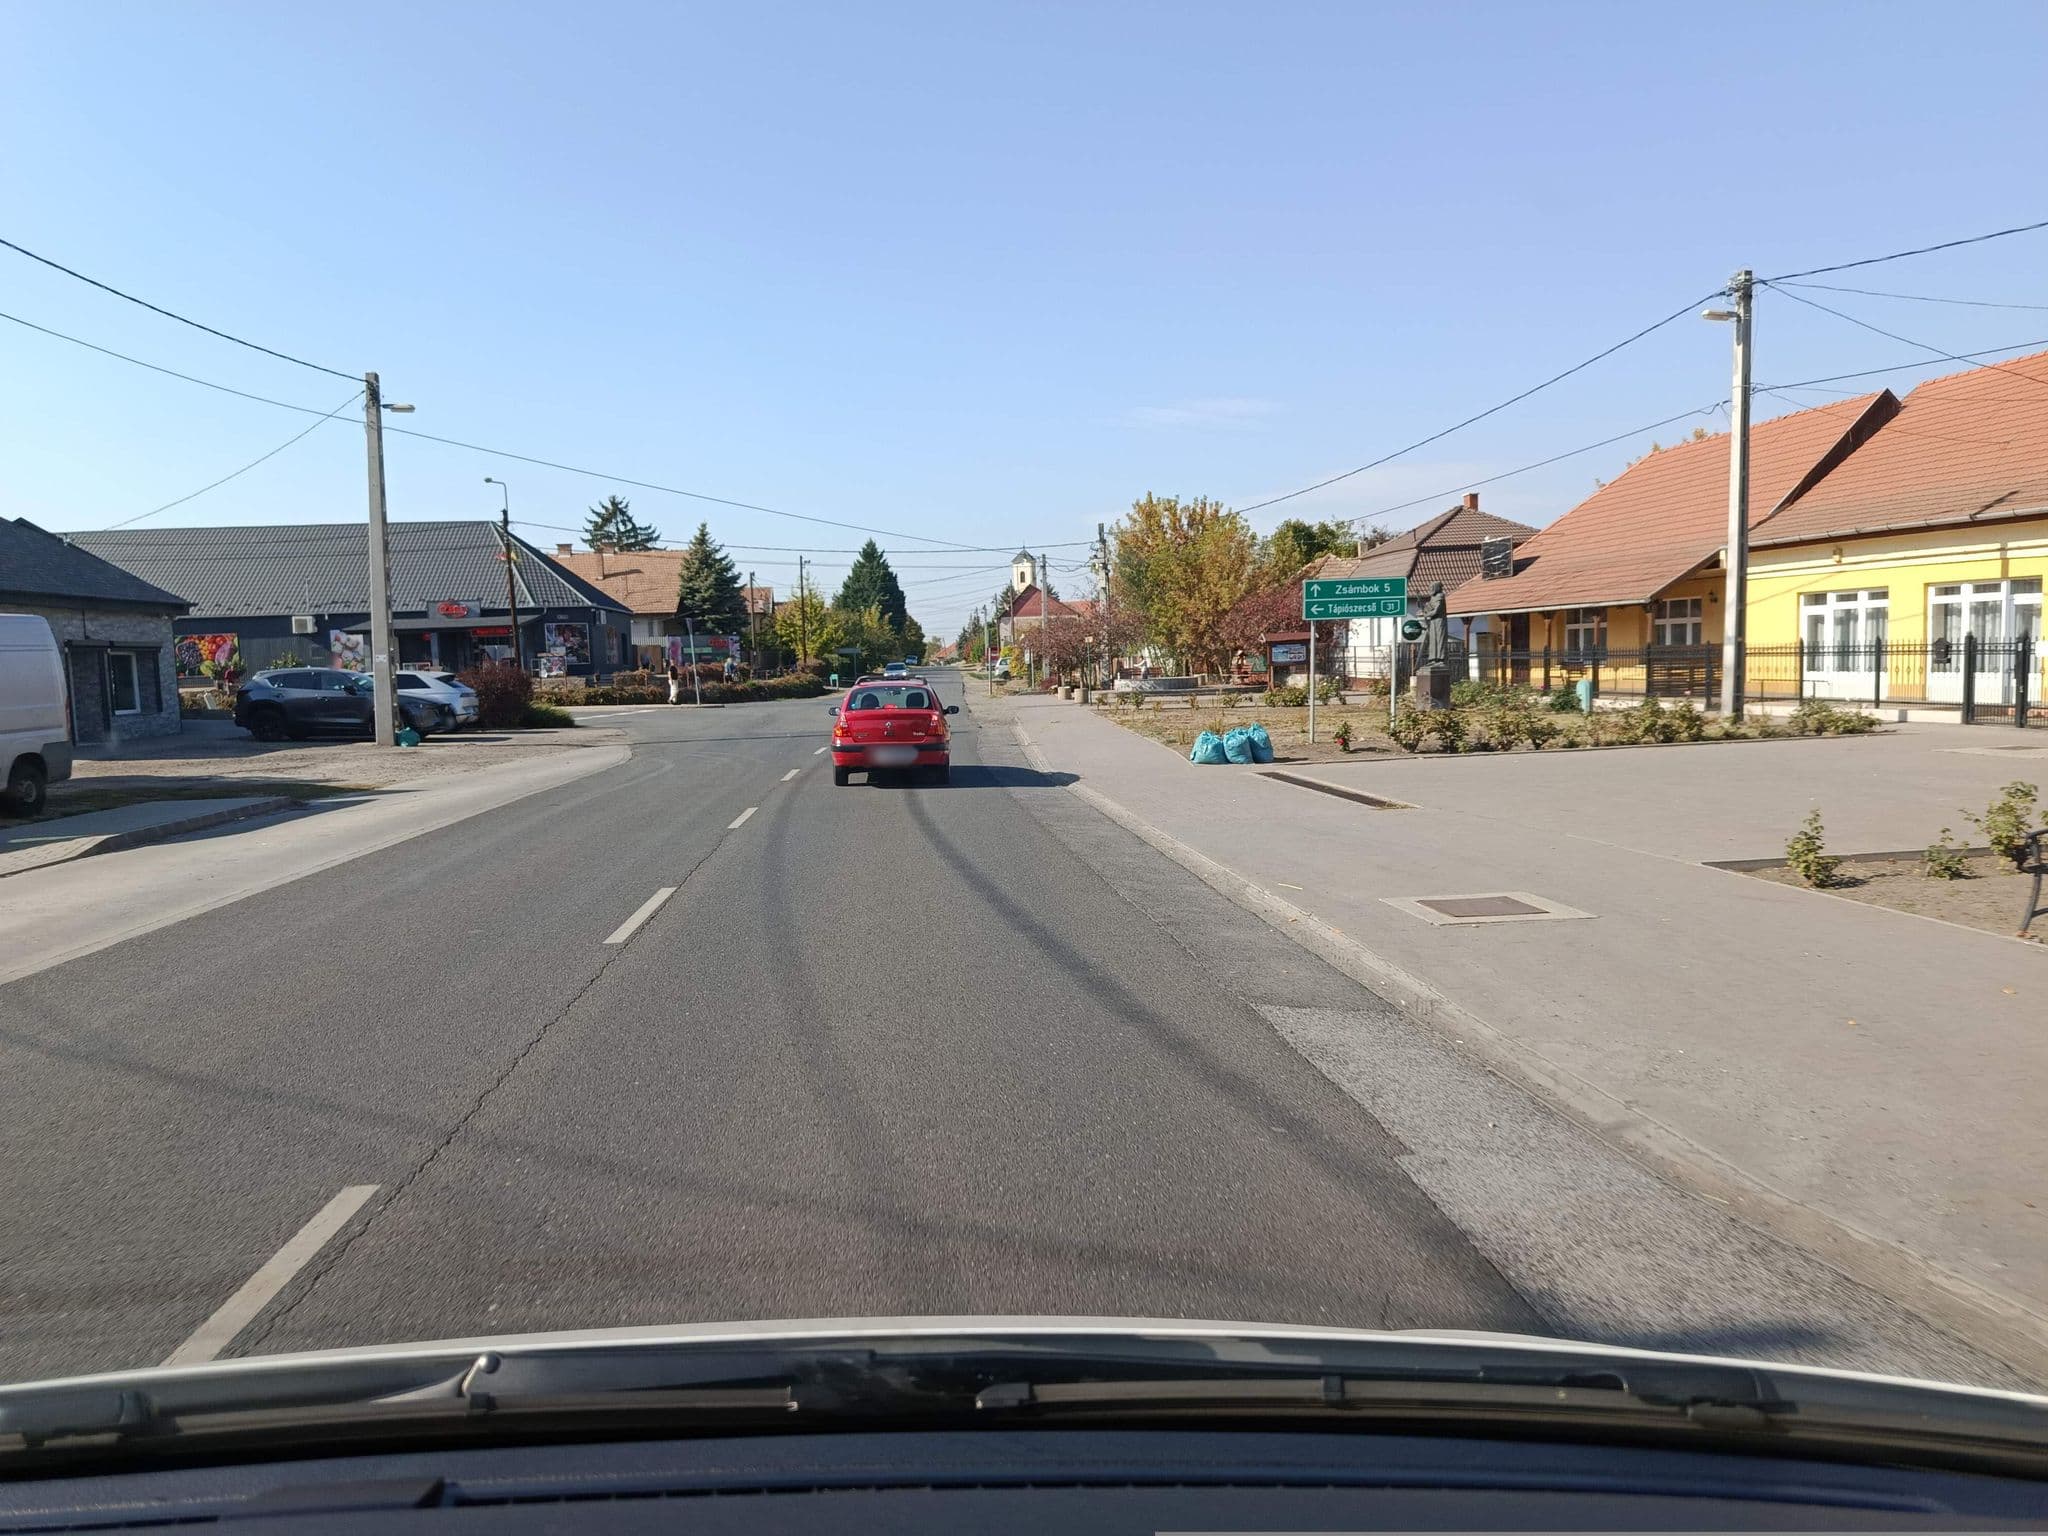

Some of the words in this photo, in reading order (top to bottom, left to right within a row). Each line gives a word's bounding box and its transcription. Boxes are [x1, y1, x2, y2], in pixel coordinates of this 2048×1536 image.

[1335, 583, 1379, 595] Zsámbok
[1384, 583, 1391, 592] 5
[1328, 602, 1377, 615] Tápiószecső
[1386, 603, 1395, 611] 31
